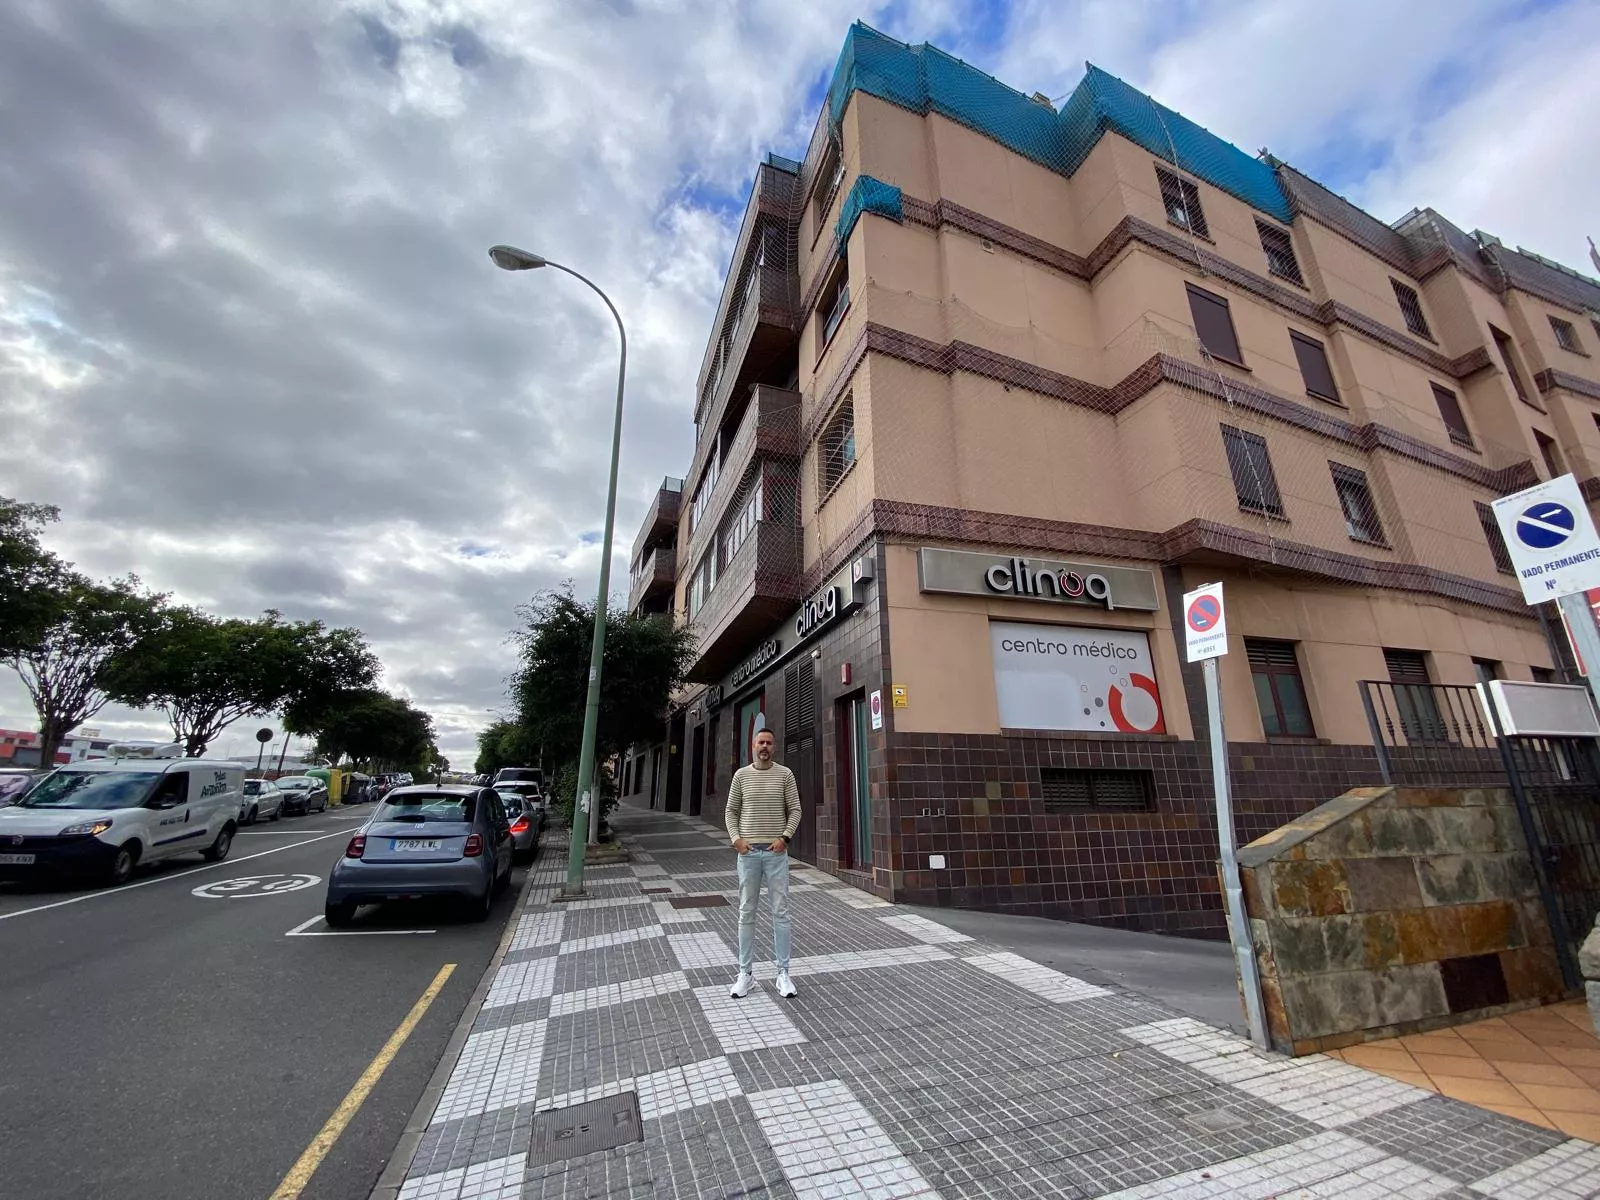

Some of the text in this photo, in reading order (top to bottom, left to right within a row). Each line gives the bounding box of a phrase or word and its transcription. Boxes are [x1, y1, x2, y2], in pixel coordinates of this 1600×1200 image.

[1521, 549, 1600, 579] VADO PERMANENTE
[1001, 637, 1138, 660] centro médico
